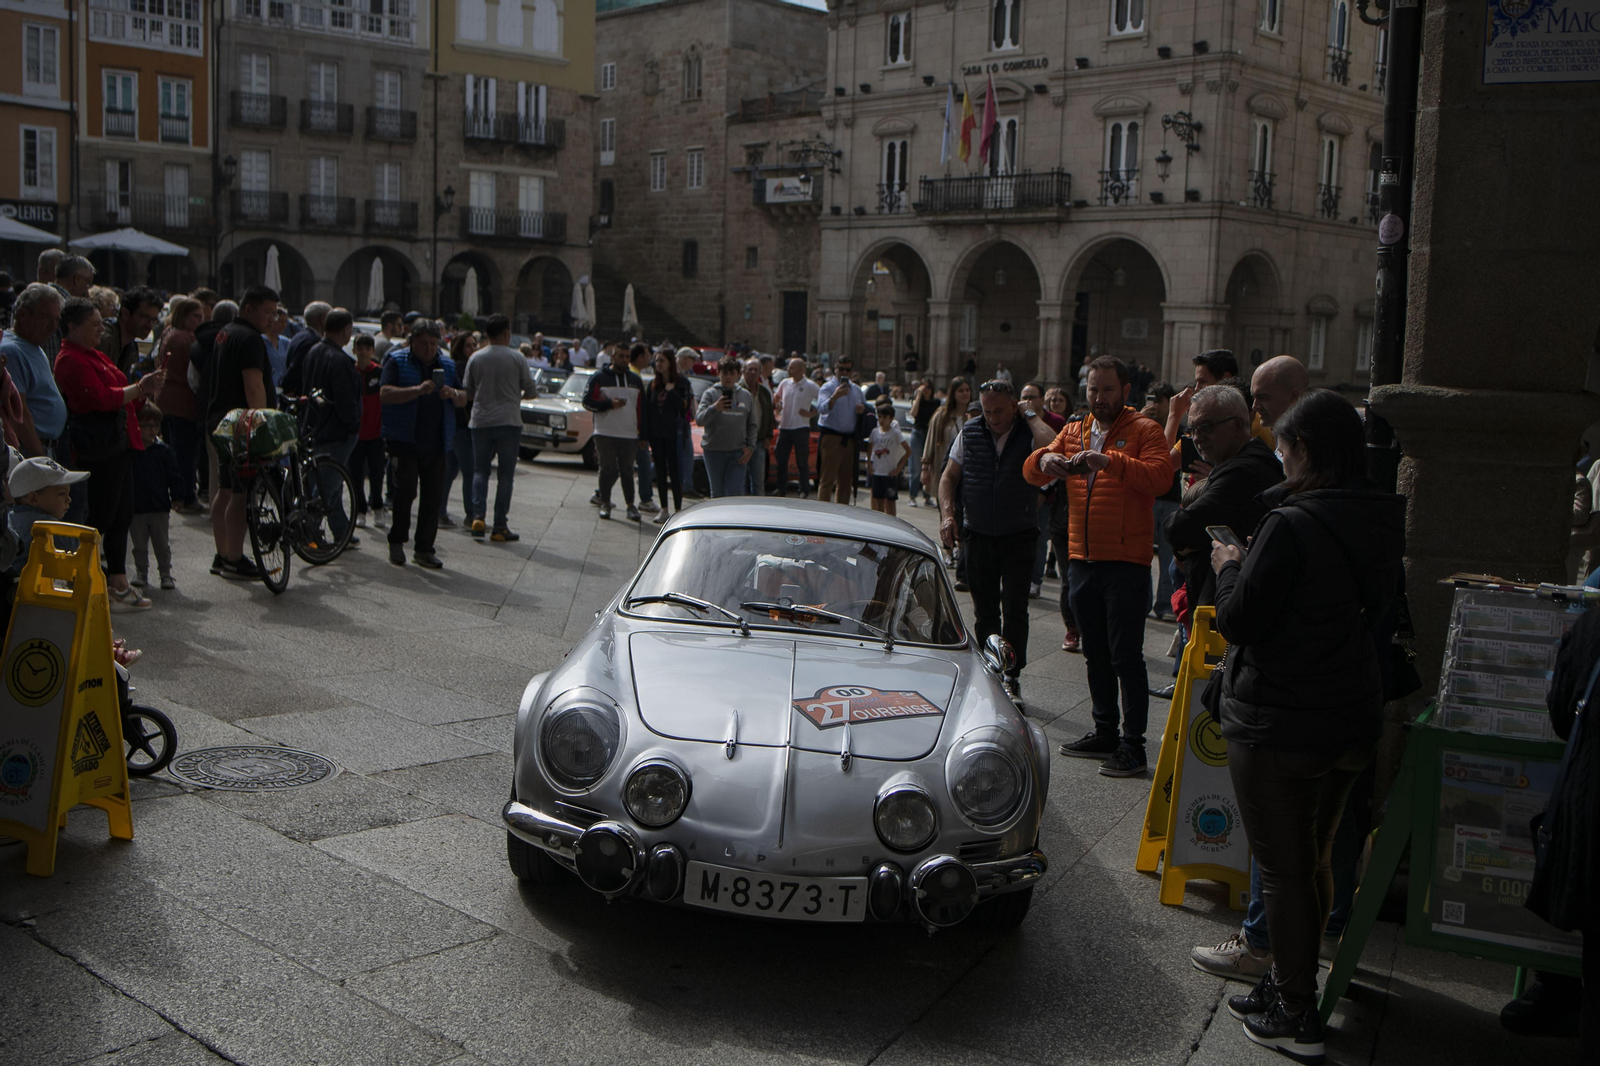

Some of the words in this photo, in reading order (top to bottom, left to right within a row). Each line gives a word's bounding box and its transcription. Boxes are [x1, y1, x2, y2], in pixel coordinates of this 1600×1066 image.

[1516, 40, 1539, 48] PRAZA
[1541, 40, 1554, 48] DO
[1572, 48, 1595, 56] PRAZA
[1492, 57, 1521, 66] CENTRO
[1565, 56, 1576, 64] DA
[961, 65, 982, 76] CASA
[1003, 58, 1048, 71] CONCELLO
[1492, 66, 1510, 74] CASA
[1512, 65, 1525, 73] DO
[1526, 65, 1564, 73] CONCELLO
[18, 204, 54, 222] LENTES
[836, 688, 865, 697] 00
[806, 700, 850, 725] 27
[853, 705, 937, 720] OURENSE
[85, 709, 112, 753] ATTENTION
[1200, 841, 1233, 852] OURENSE
